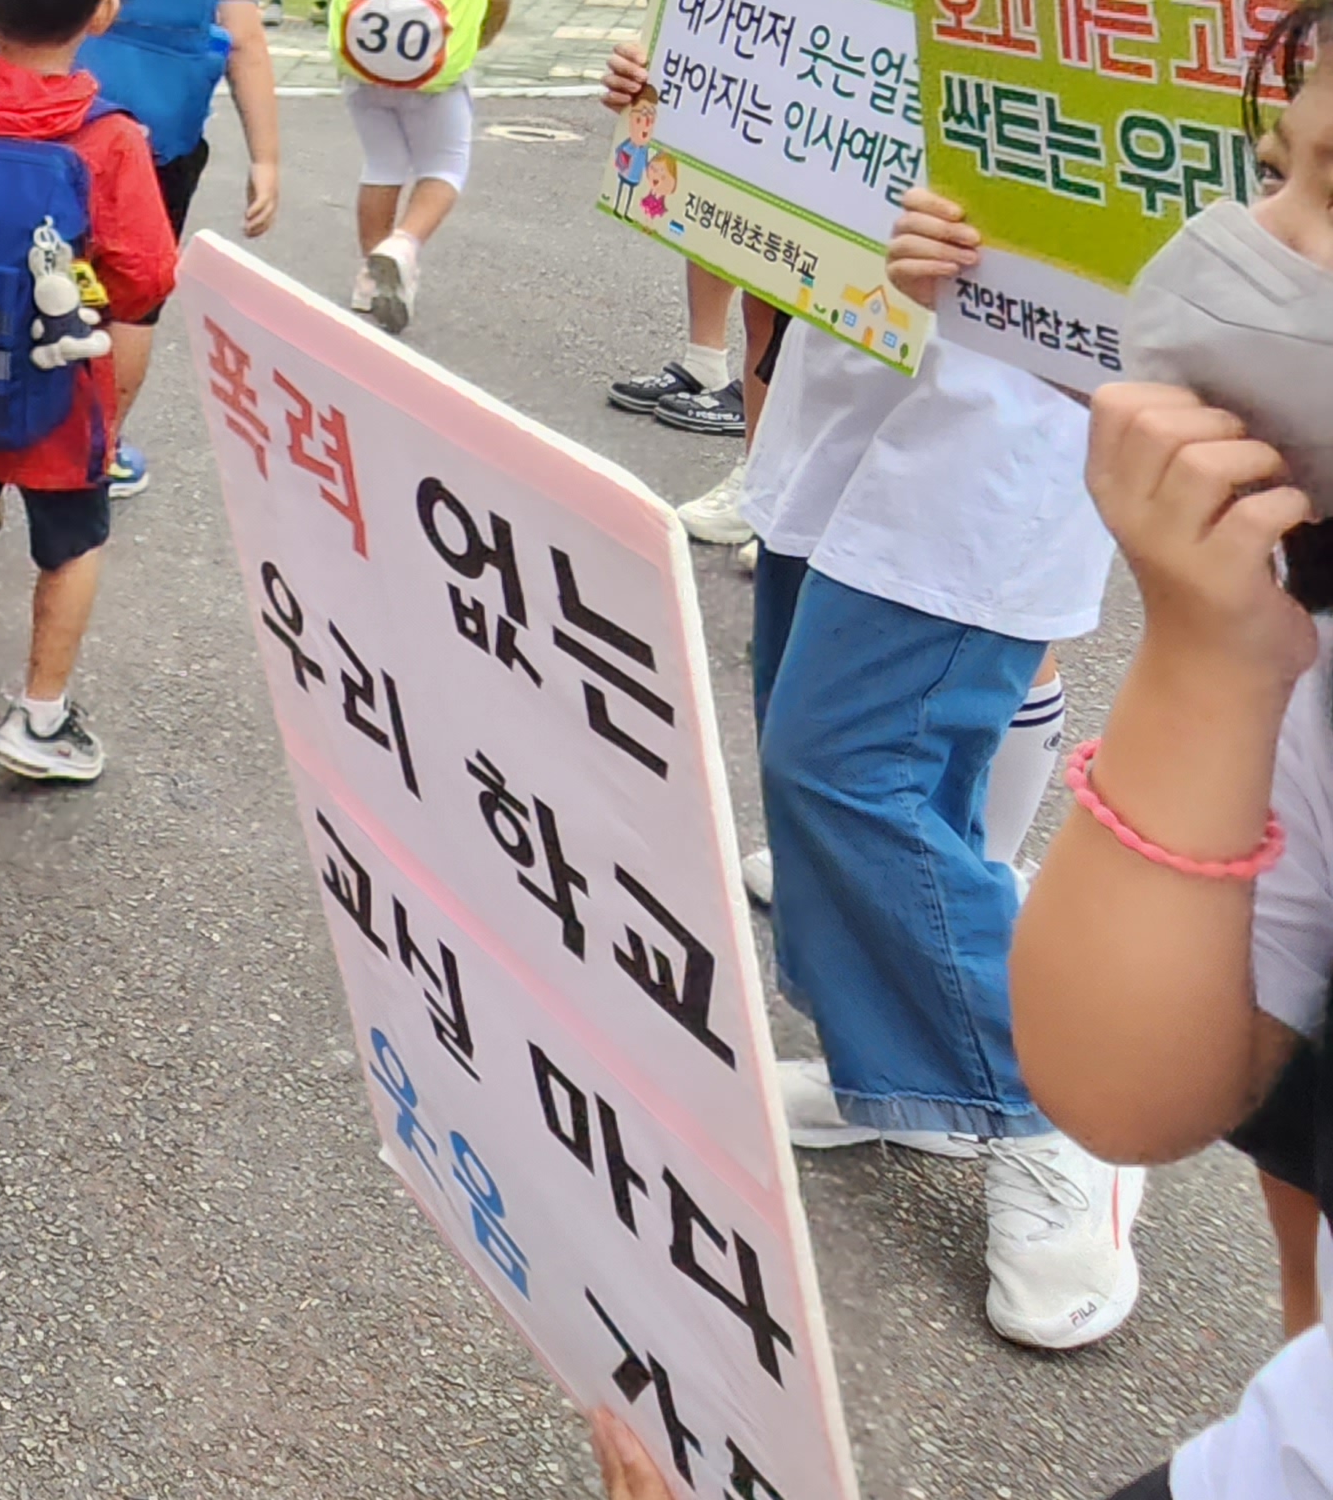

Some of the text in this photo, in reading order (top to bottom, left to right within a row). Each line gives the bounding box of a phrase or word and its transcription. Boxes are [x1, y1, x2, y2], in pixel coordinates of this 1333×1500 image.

[356, 12, 431, 62] 30
[658, 49, 923, 208] 밝아지는 인사예절
[940, 72, 1106, 205] 싹트는
[683, 192, 819, 281] 진영대창초등학교
[203, 314, 675, 781] 폭력 없는
[261, 561, 737, 1072] 우리 학교
[316, 808, 796, 1388] 교실 마다
[370, 1027, 531, 1302] 웃음
[1068, 1301, 1097, 1327] FILA
